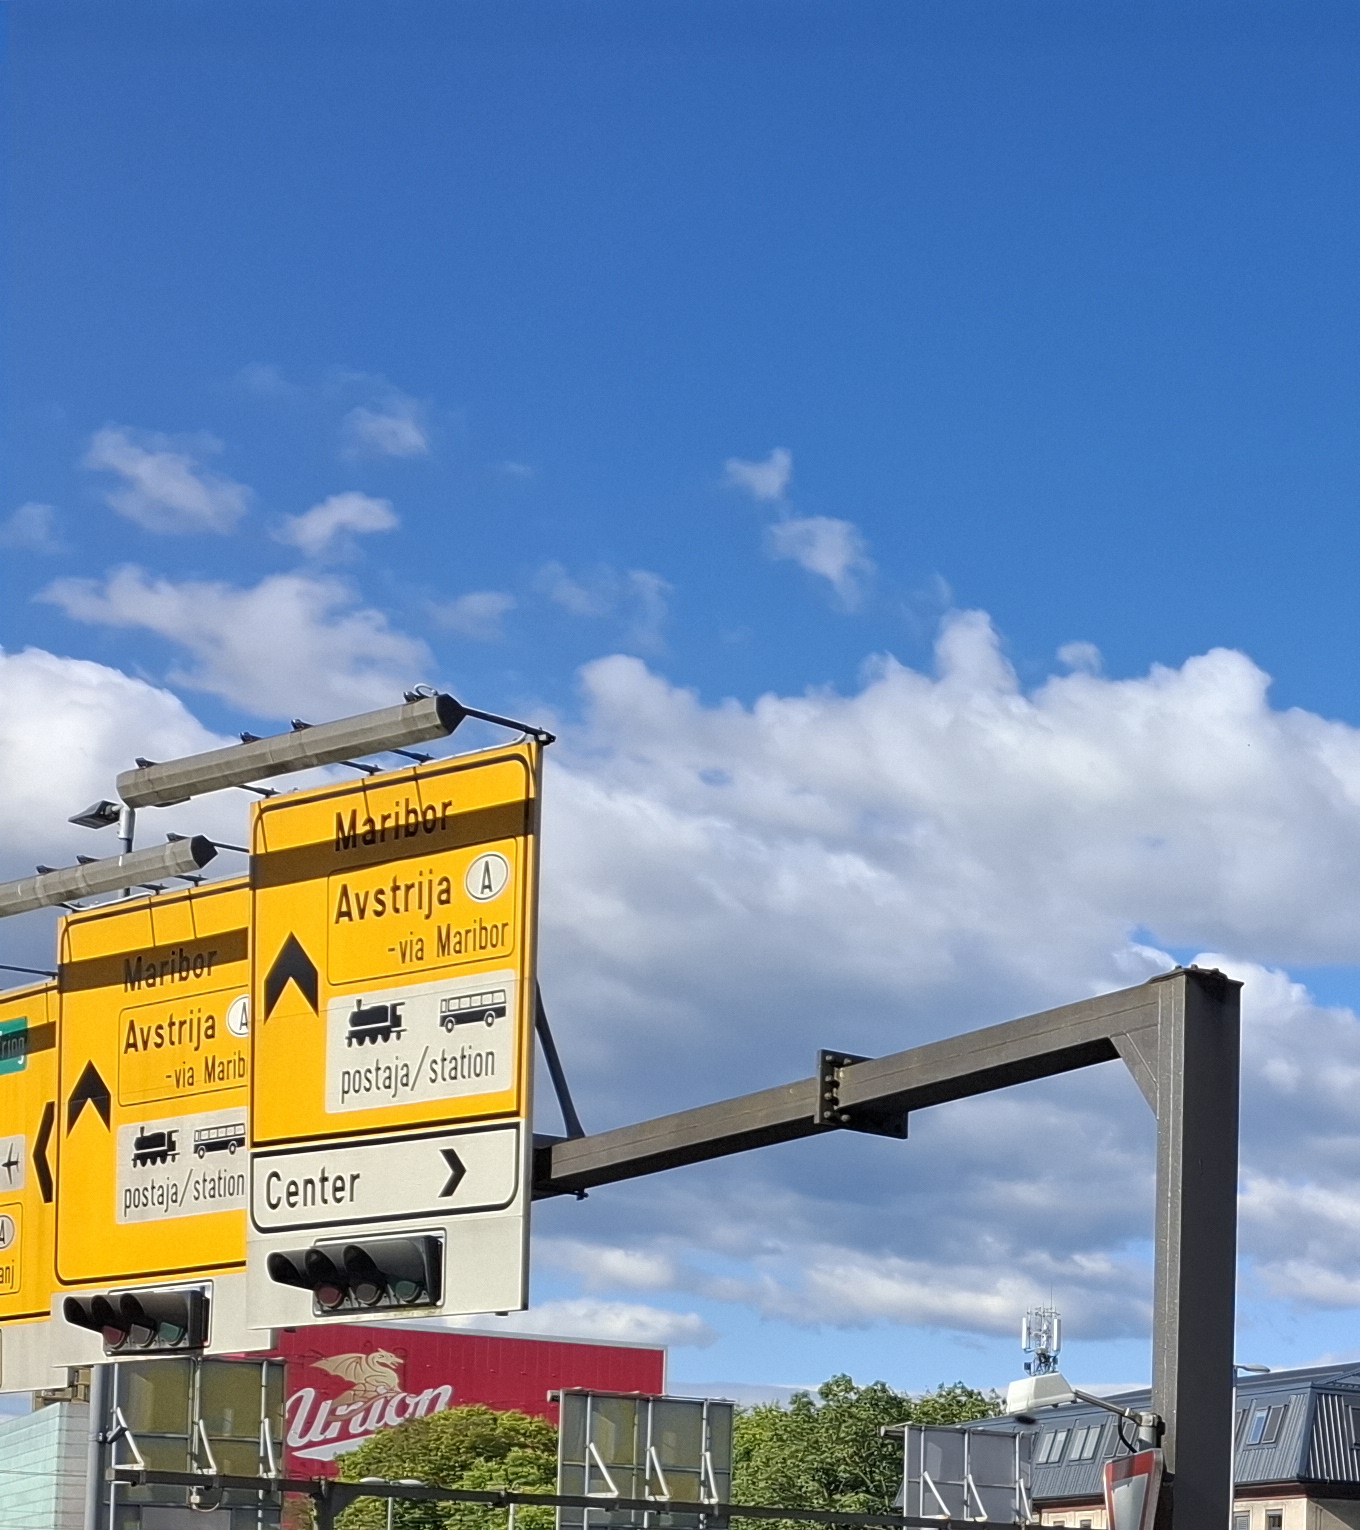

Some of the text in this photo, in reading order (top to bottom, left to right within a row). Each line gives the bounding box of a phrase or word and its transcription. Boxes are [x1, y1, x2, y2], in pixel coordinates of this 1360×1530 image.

[334, 797, 452, 853] Maribor
[335, 859, 494, 925] Avstrija A
[436, 916, 510, 959] Maribor
[123, 948, 218, 993] Maribor
[123, 1007, 216, 1055] Avstrija
[340, 1045, 496, 1104] postaja/station
[265, 1165, 361, 1211] Center
[286, 1384, 454, 1447] Union
